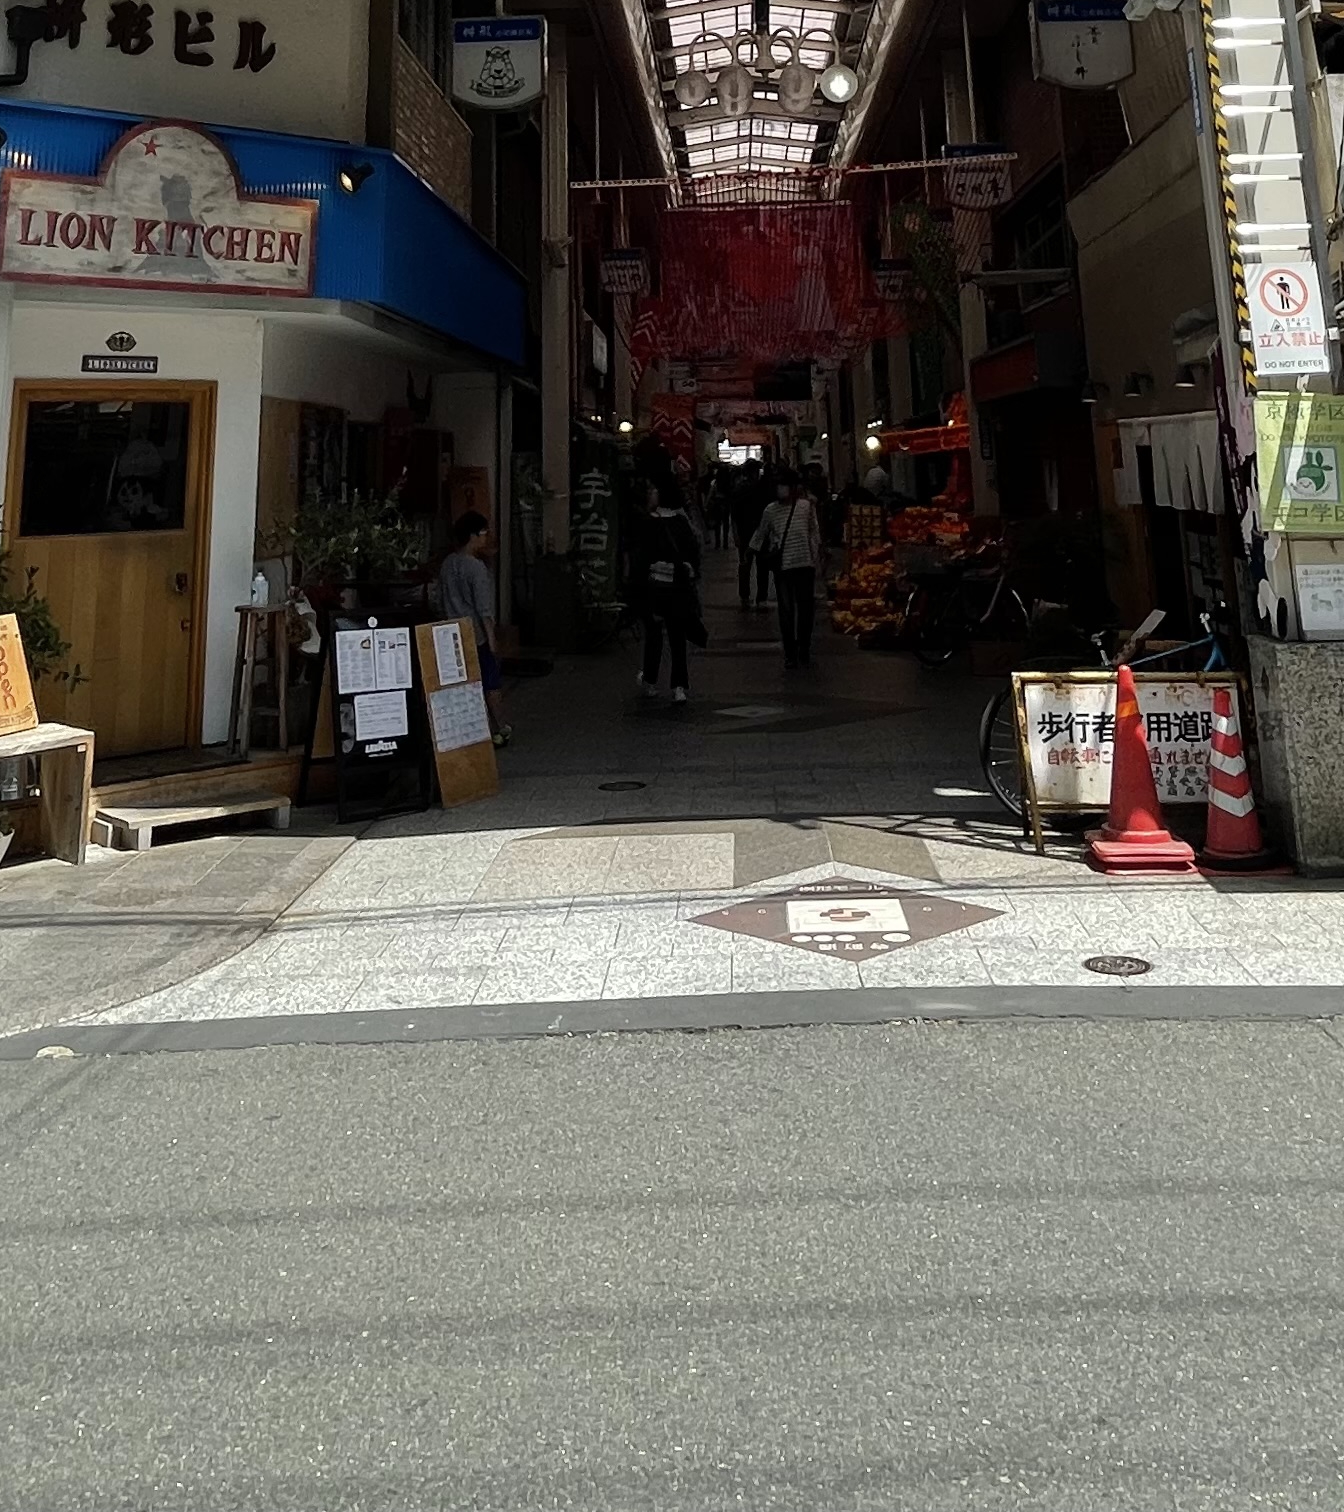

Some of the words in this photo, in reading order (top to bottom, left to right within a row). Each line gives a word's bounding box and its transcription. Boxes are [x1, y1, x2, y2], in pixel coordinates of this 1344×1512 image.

[17, 208, 118, 253] LION
[132, 217, 304, 266] KITCHEN
[1258, 331, 1324, 348] 立入禁止
[1265, 361, 1277, 369] DO
[1279, 360, 1296, 368] NOT
[1298, 359, 1324, 369] ENTER
[1038, 711, 1213, 743] 歩行者用道
